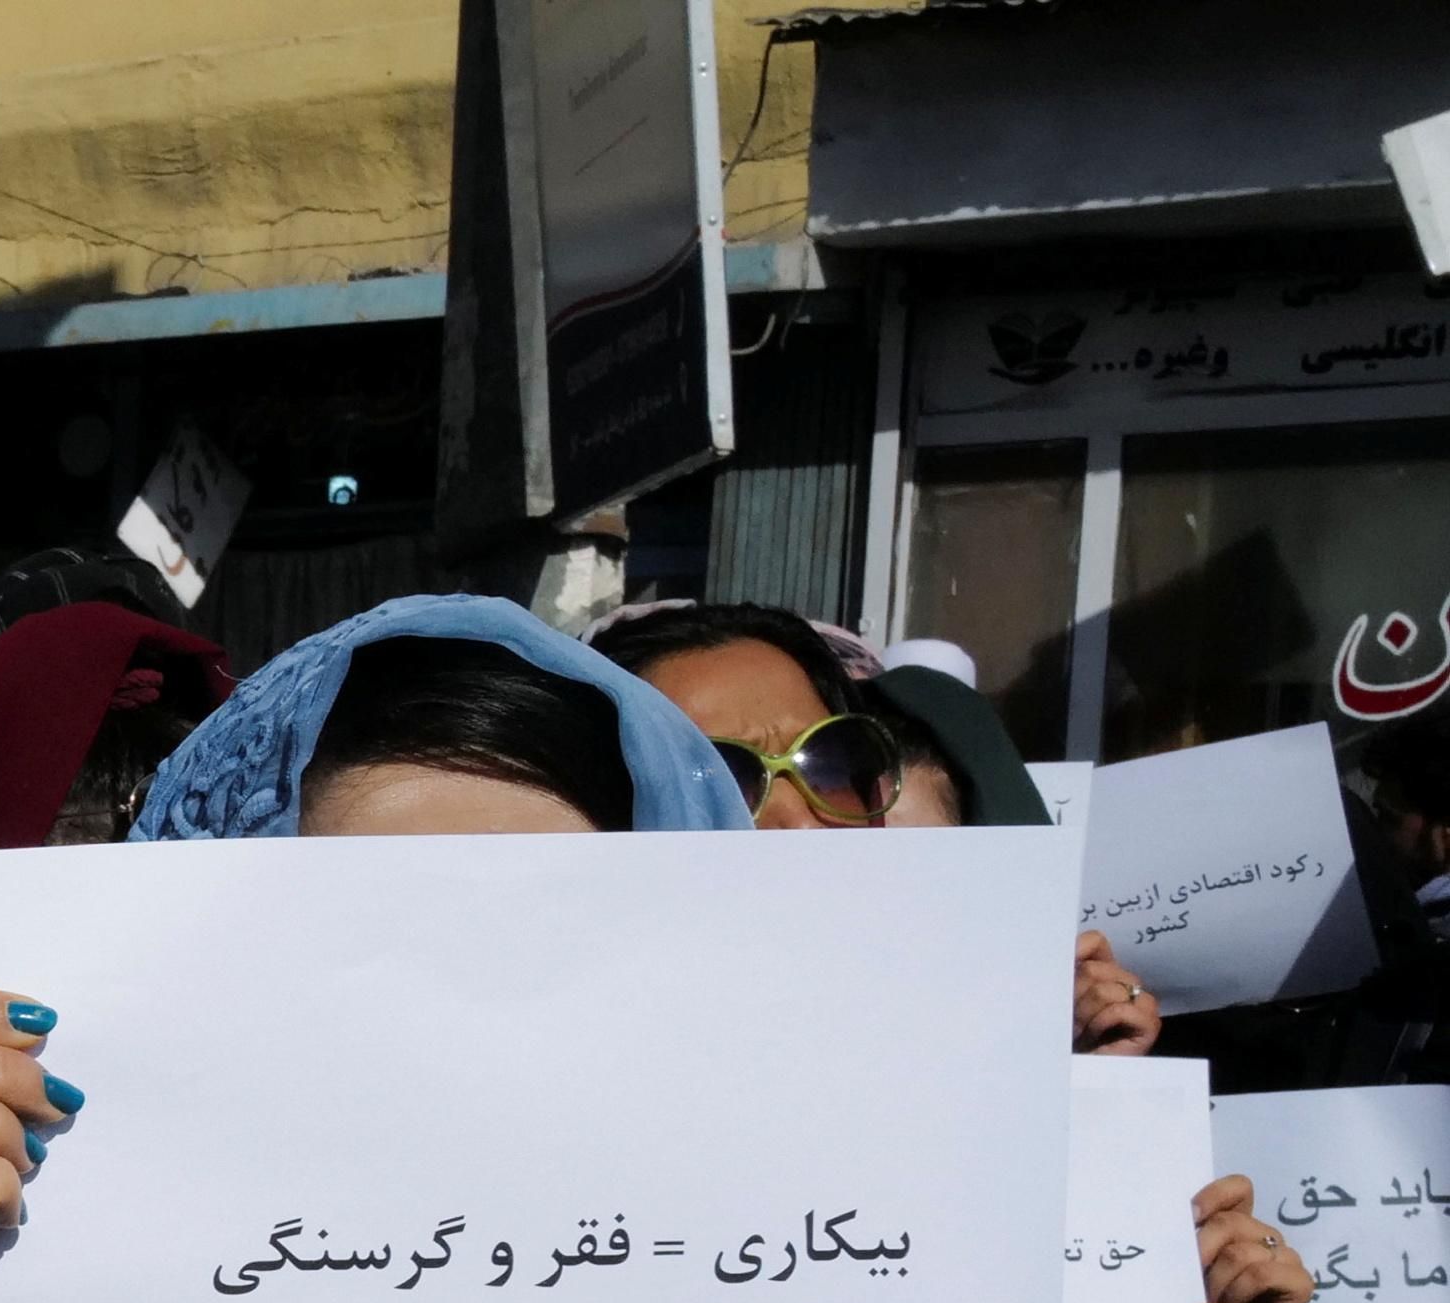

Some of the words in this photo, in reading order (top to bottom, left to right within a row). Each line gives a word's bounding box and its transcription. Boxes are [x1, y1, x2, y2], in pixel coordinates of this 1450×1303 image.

[1169, 863, 1262, 905] اقتصادی
[1270, 853, 1324, 880] رکود
[1134, 910, 1190, 945] کشور
[1277, 1175, 1357, 1227] حق
[212, 1215, 467, 1296] گرسنگی
[485, 1241, 514, 1287] و
[535, 1213, 631, 1288] فقر
[714, 1209, 911, 1284] بیکاری
[1099, 1240, 1146, 1271] حق
